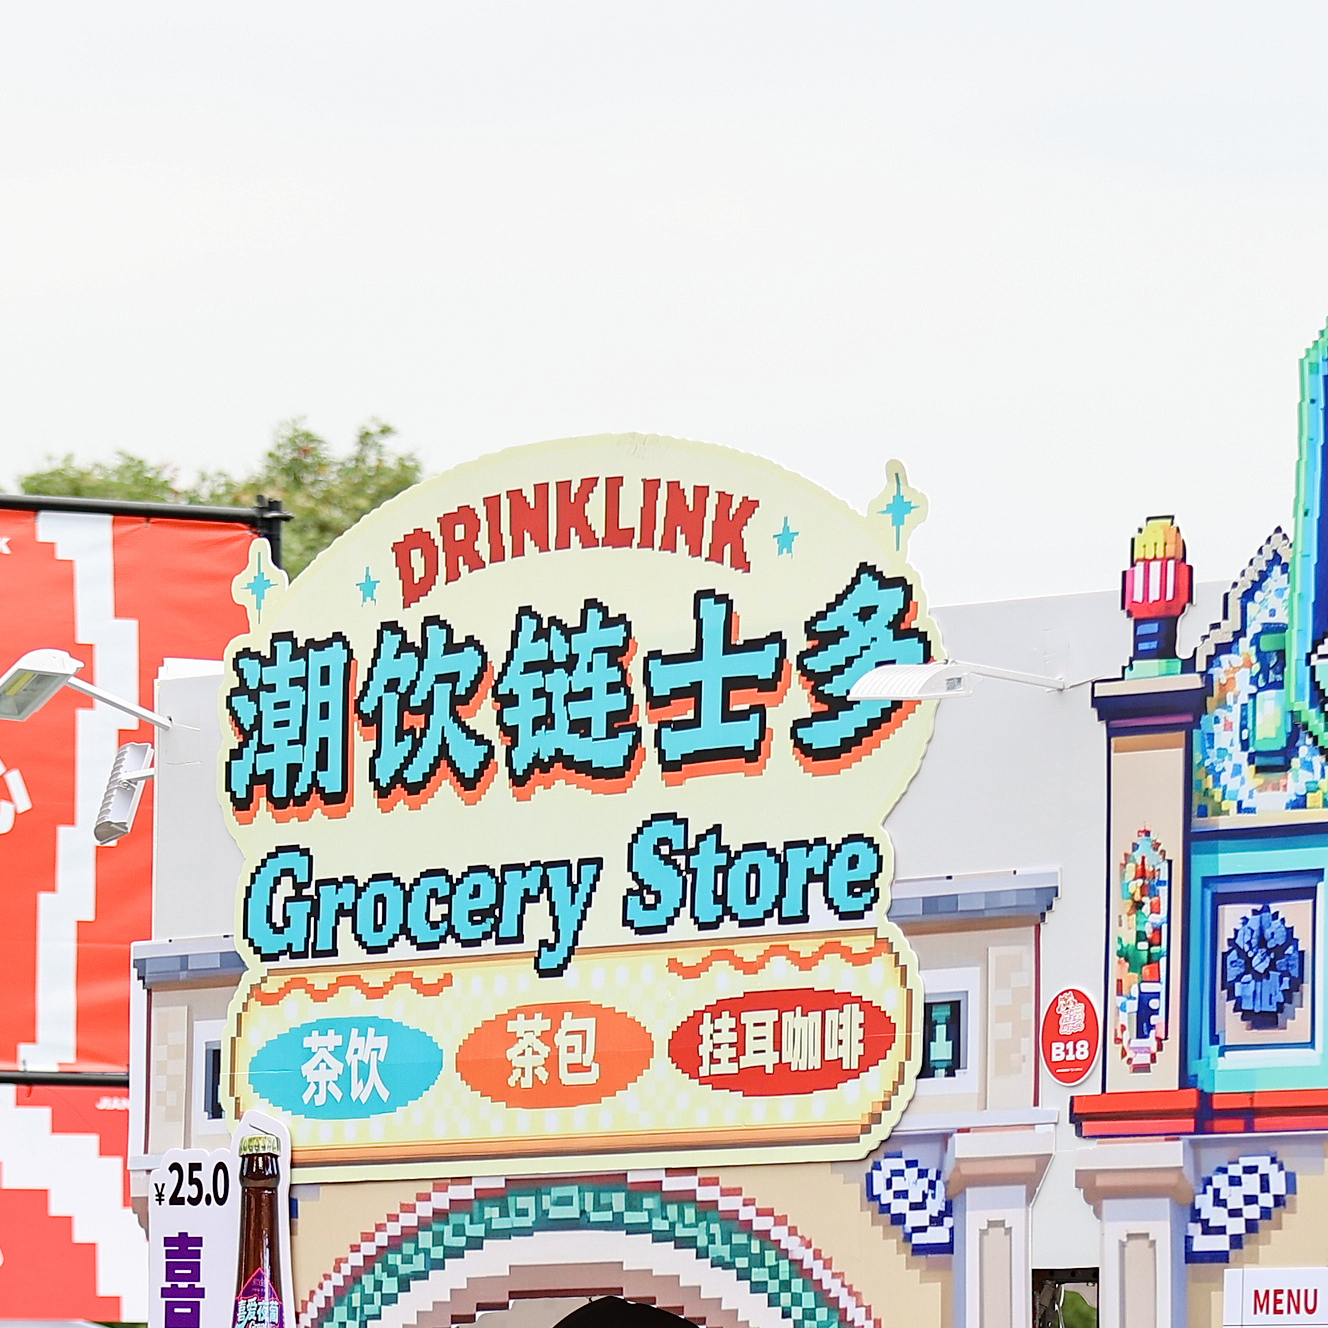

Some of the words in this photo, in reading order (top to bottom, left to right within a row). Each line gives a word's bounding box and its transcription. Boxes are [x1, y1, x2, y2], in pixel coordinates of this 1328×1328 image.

[392, 475, 759, 608] DRINKLINK
[226, 563, 931, 812] 潮饮链士多
[242, 845, 604, 977] Grocery
[622, 812, 883, 936] Store
[300, 1029, 389, 1108] 茶饮
[505, 1009, 600, 1091] 茶包
[699, 1007, 866, 1075] 挂耳咖啡
[1051, 1040, 1089, 1062] B18
[154, 1161, 230, 1207] ¥25.0
[1253, 1289, 1318, 1315] MENU
